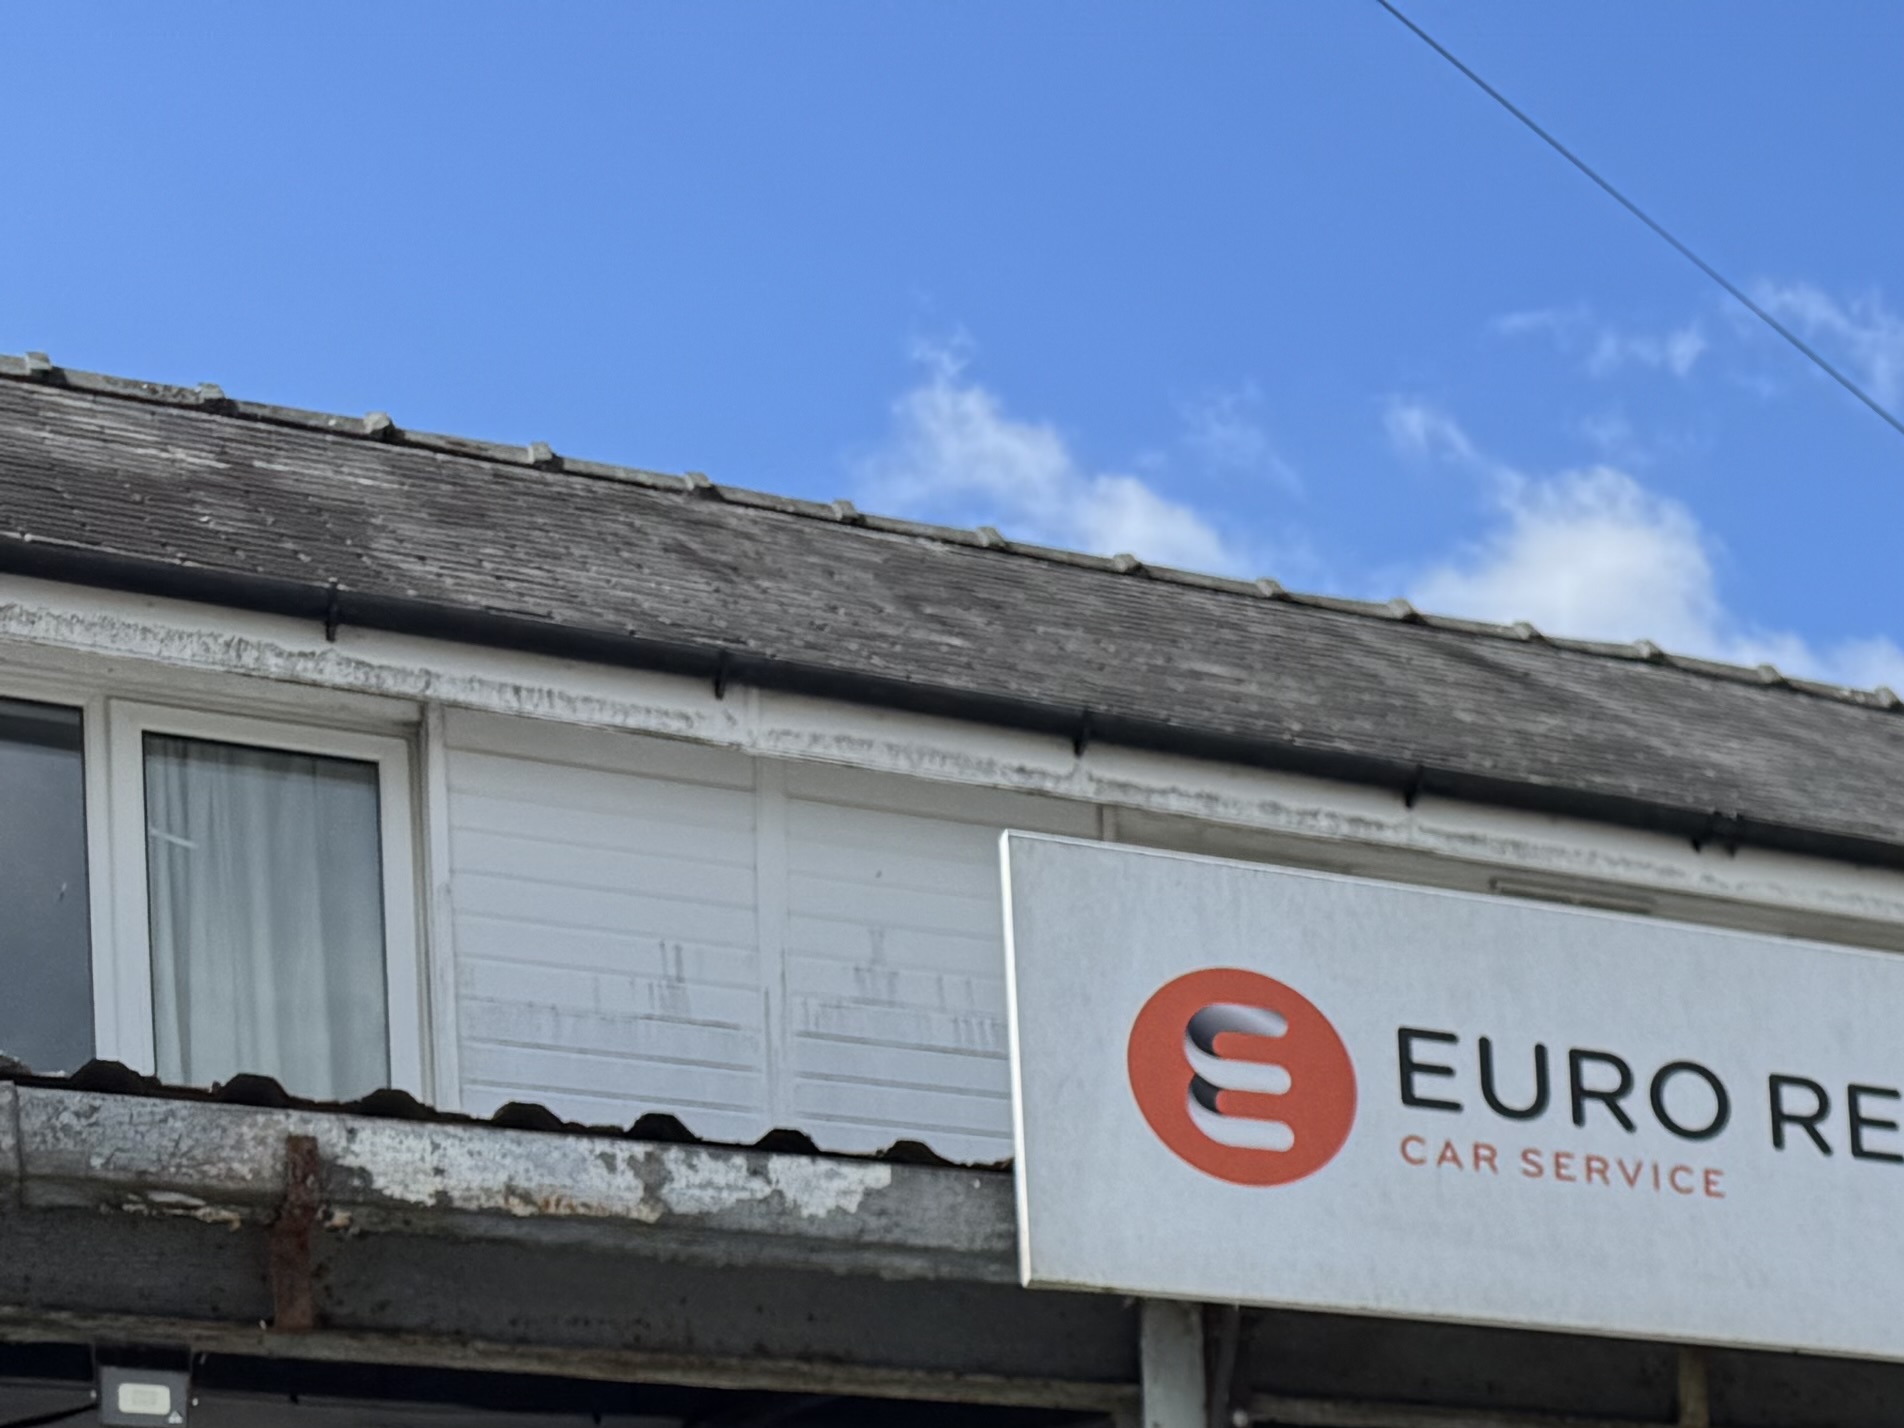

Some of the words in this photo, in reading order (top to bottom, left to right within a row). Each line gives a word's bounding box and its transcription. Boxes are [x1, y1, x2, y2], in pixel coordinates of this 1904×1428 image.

[1397, 1026, 1731, 1142] EURO
[1400, 1135, 1499, 1176] CAR
[1521, 1147, 1727, 1199] SERVICE
